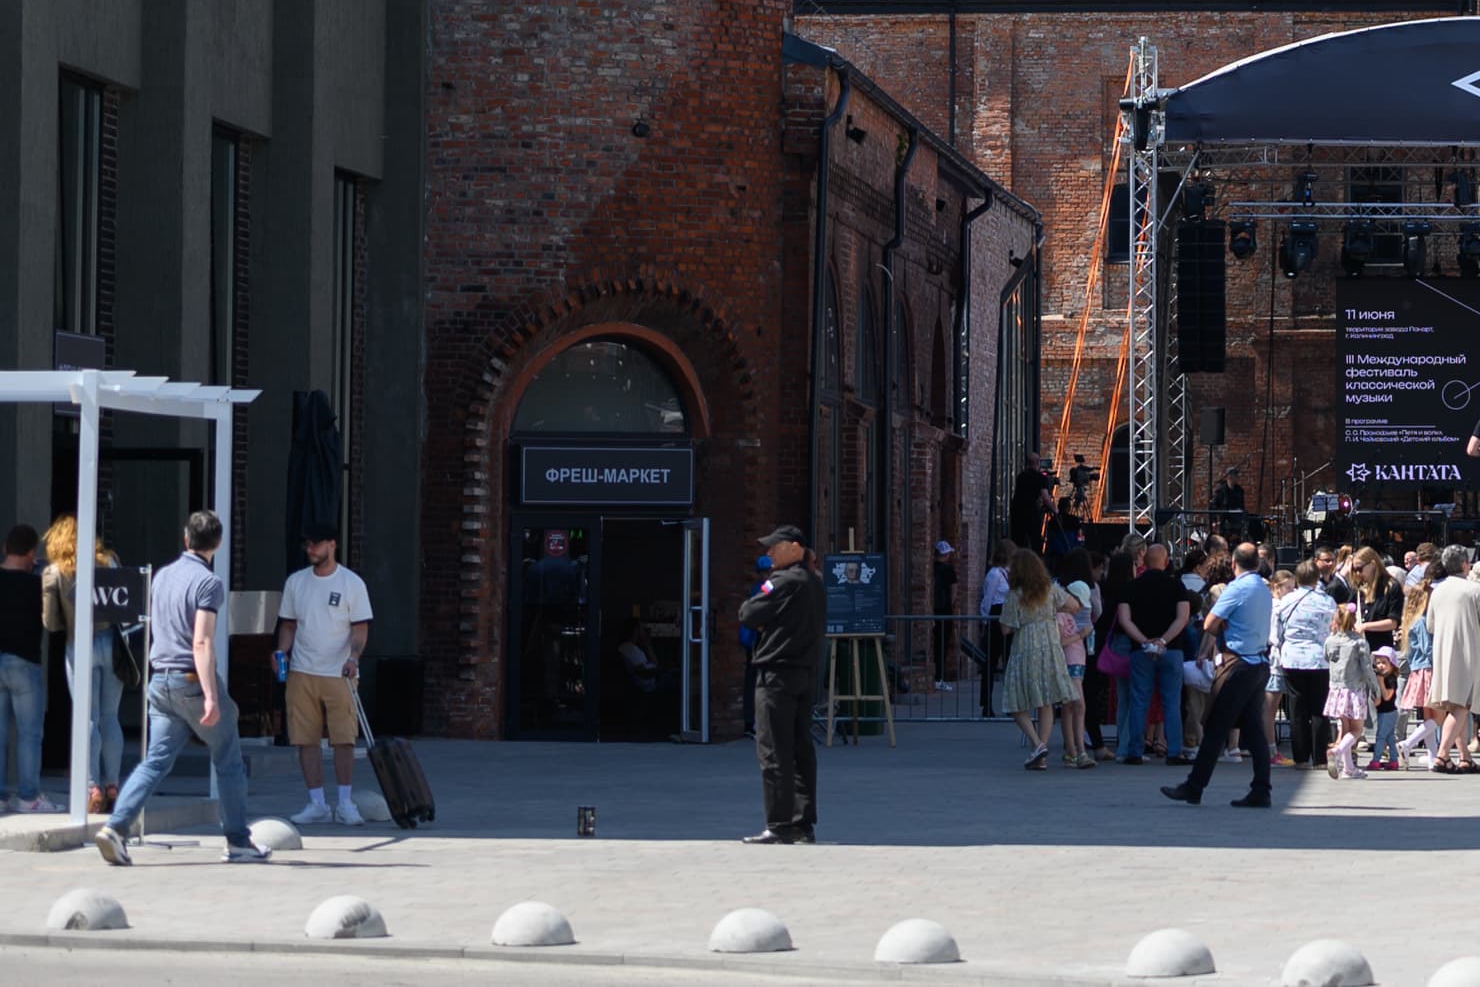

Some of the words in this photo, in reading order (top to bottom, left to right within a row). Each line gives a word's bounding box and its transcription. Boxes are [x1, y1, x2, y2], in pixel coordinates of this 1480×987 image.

[1344, 308, 1356, 320] 11
[1359, 310, 1395, 320] июня
[1345, 354, 1355, 364] III
[1357, 353, 1467, 366] Международный
[1345, 366, 1418, 379] фестиваль
[1345, 379, 1436, 391] классической
[1345, 394, 1393, 405] музыки
[545, 468, 671, 484] ФРЕШ-МАРКЕТ
[1375, 464, 1462, 481] КАНТАТА
[93, 586, 129, 606] WC
